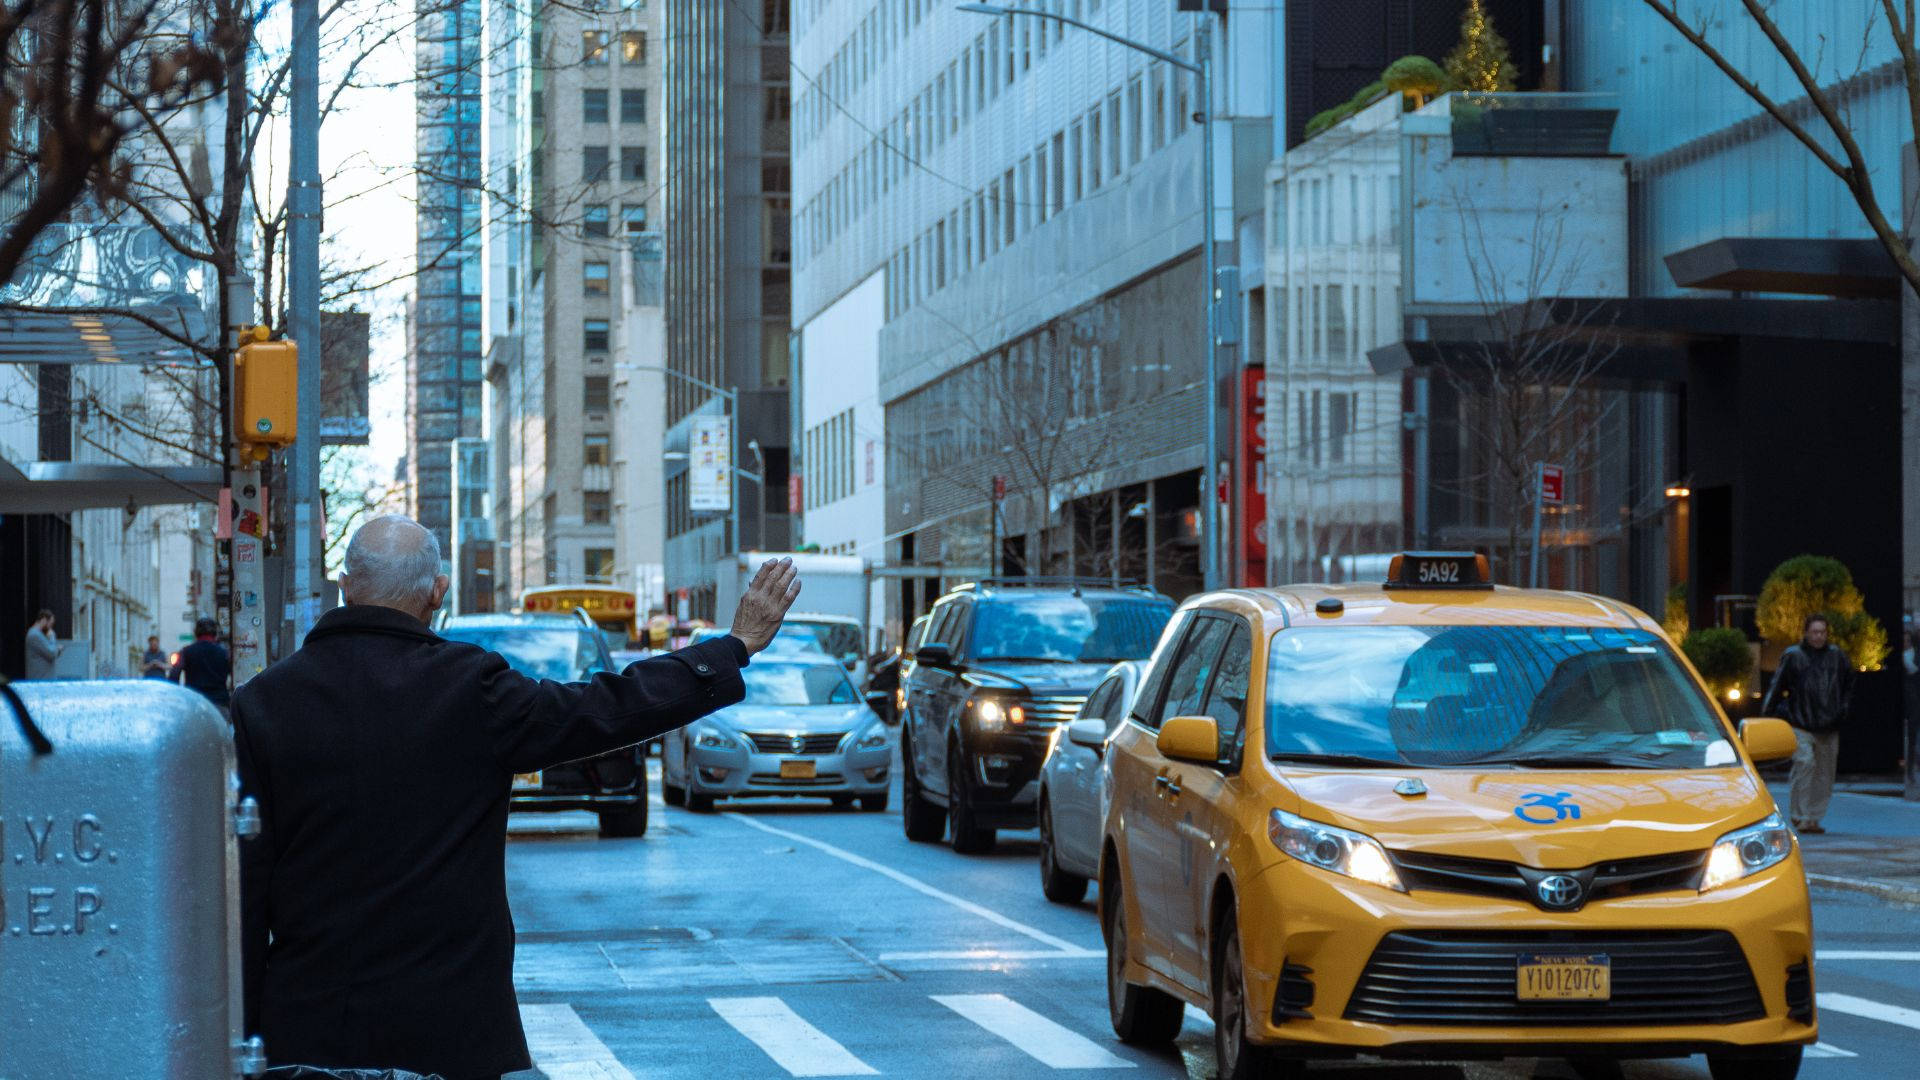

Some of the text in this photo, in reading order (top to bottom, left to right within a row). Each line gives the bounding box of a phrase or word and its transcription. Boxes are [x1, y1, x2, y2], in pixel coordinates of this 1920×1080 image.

[1419, 561, 1459, 582] 5A92
[0, 813, 118, 864] .Y.C.
[0, 887, 118, 935] .E.P.
[1527, 968, 1601, 991] Y101207C
